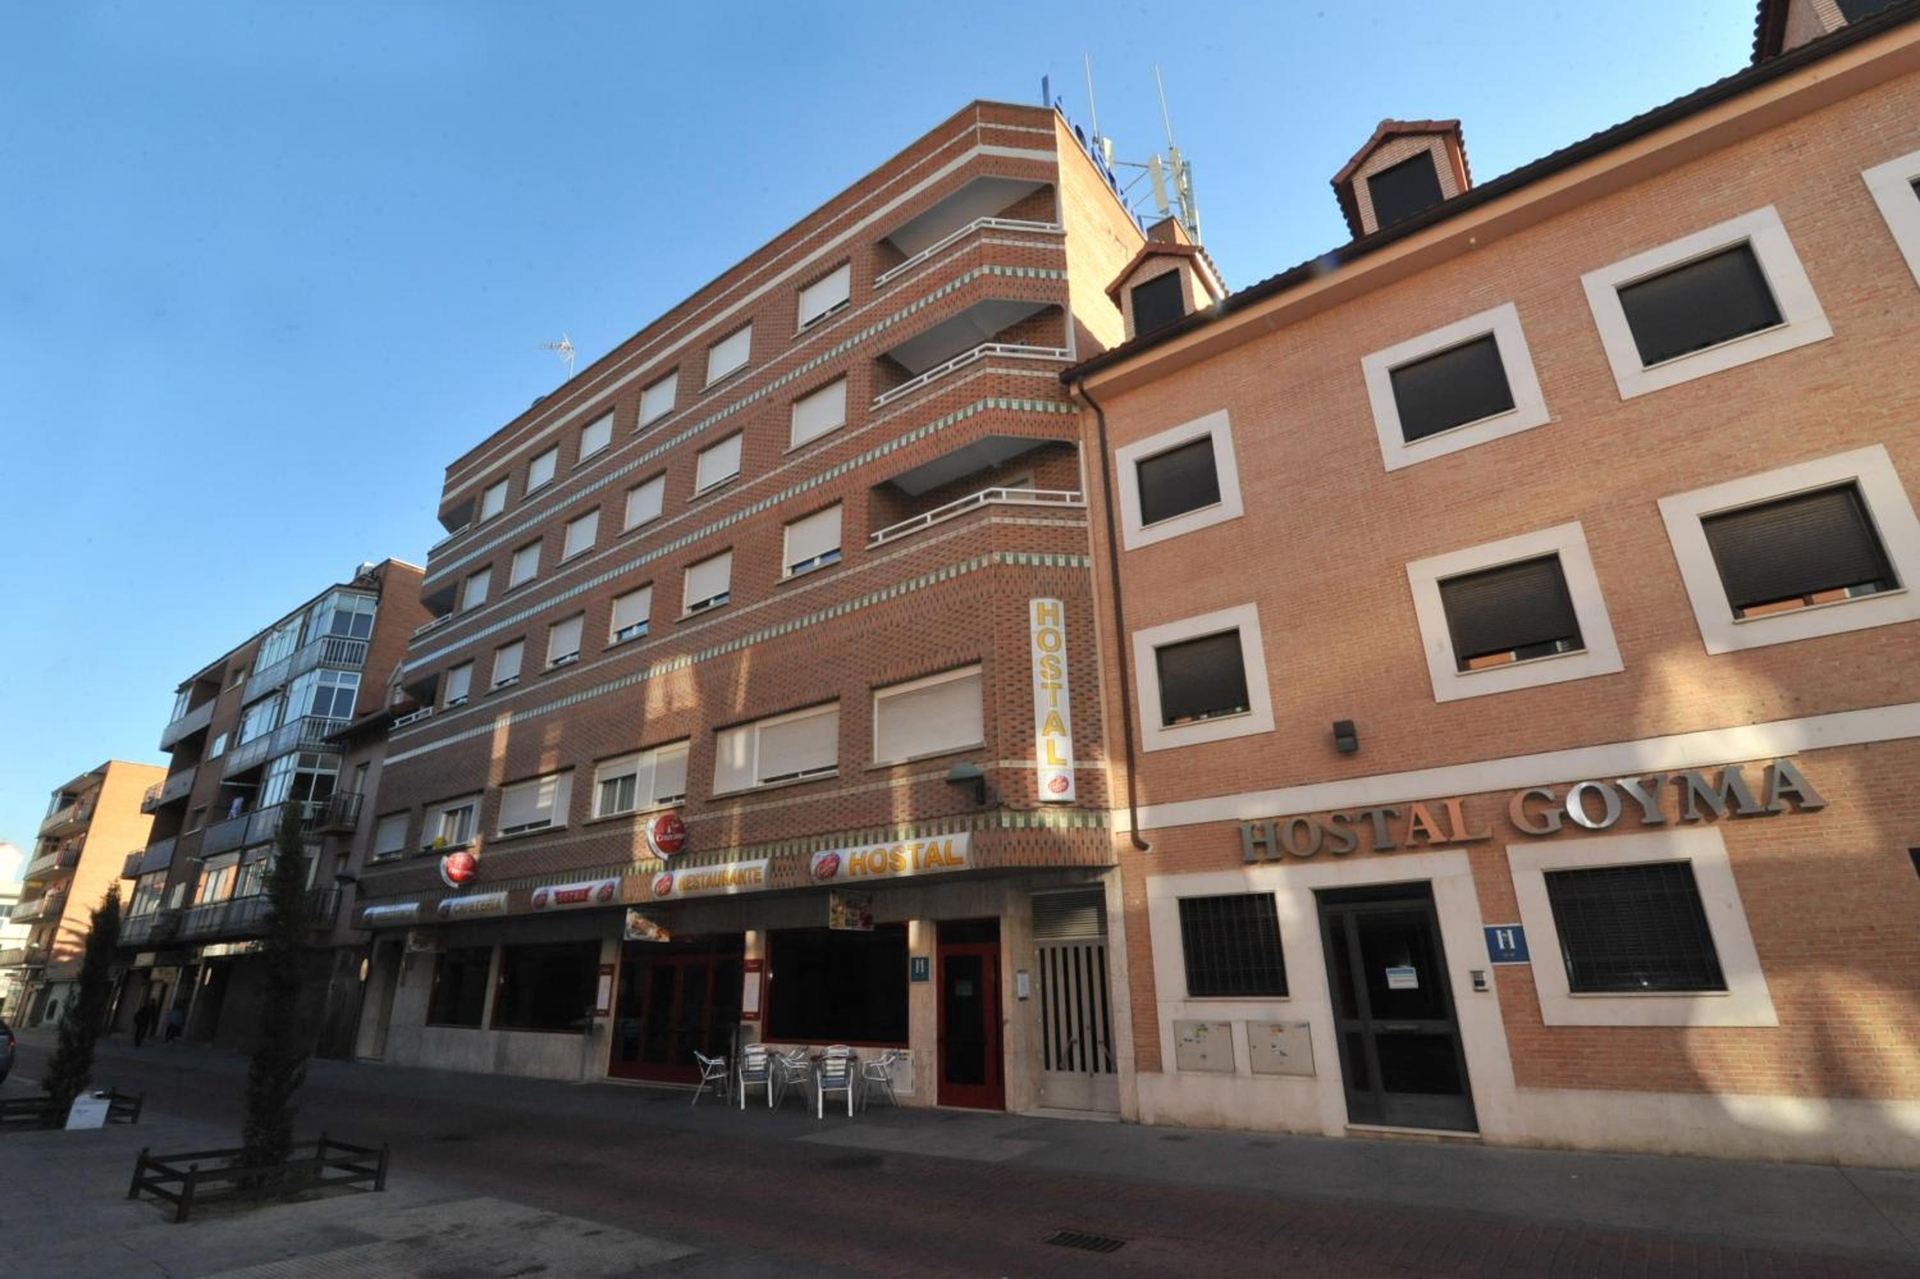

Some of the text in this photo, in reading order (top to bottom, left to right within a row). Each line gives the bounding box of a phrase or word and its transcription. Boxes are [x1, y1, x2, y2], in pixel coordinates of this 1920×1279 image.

[1036, 602, 1067, 765] HOSTAL
[849, 839, 963, 876] HOSTAL
[1238, 758, 1828, 864] HOSTAL GOYMA
